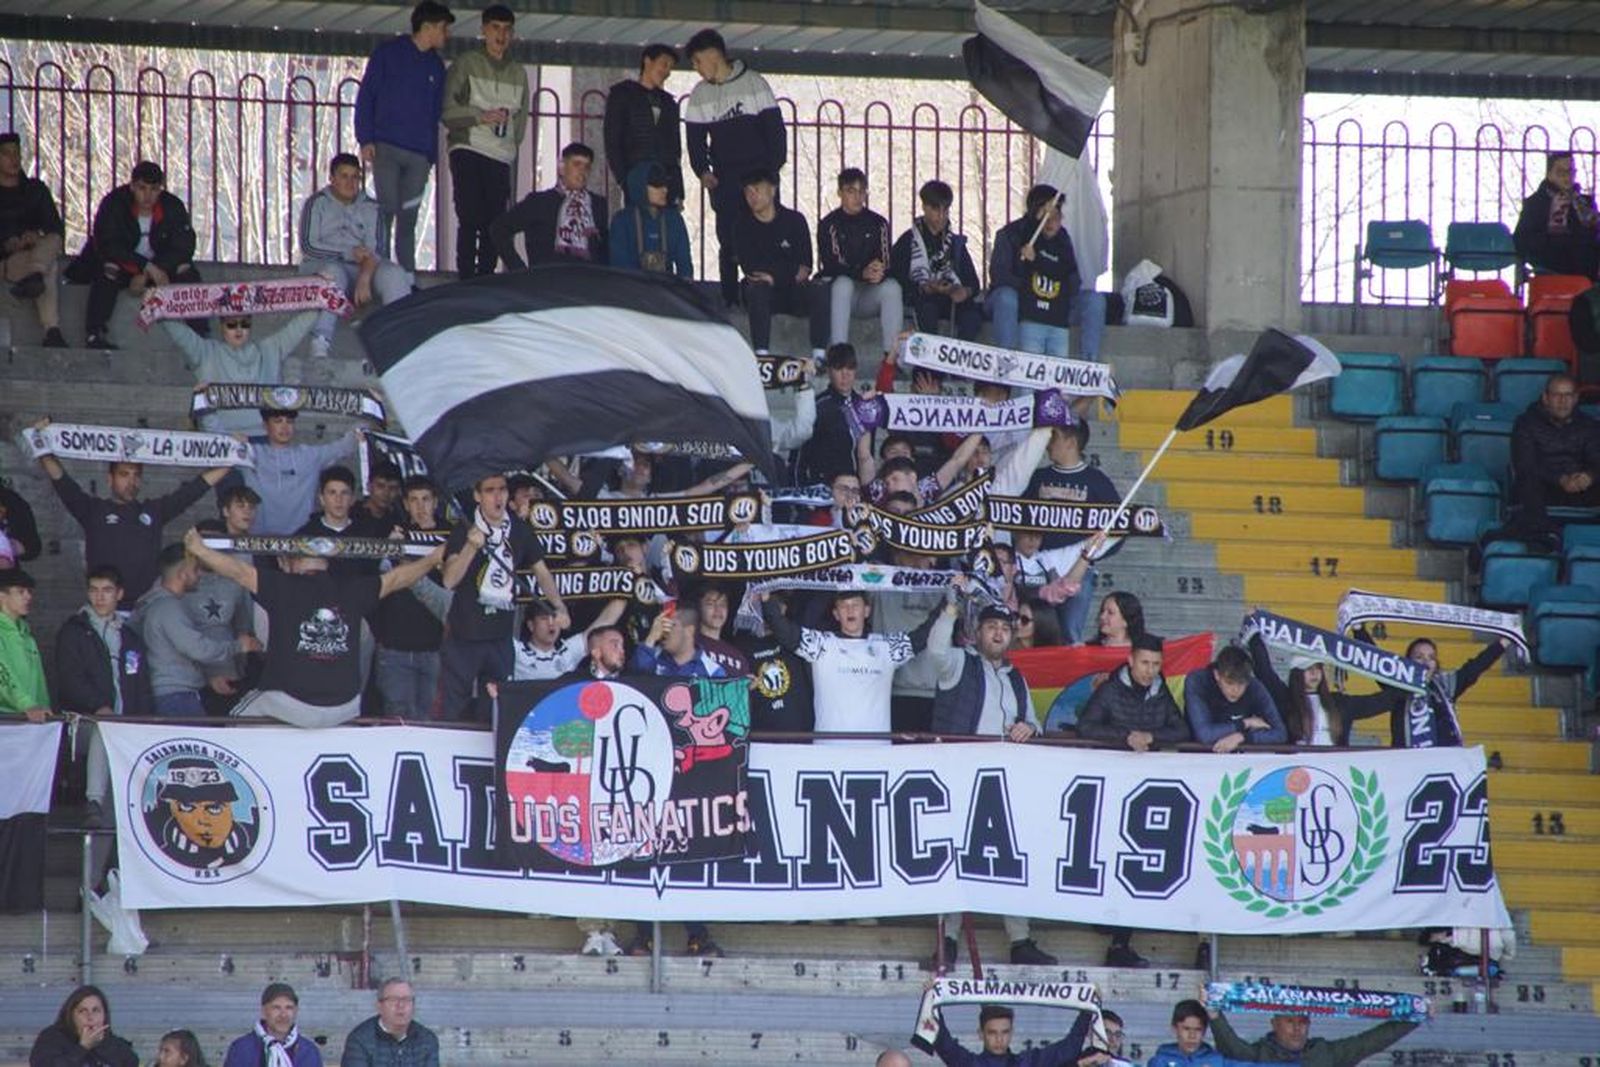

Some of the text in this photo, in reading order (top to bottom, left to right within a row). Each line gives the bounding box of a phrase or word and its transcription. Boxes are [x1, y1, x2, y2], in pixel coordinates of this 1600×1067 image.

[937, 344, 1102, 388] SOMOS LA UNIÓN
[60, 431, 231, 458] SOMOS LA UNIÓN
[1205, 429, 1234, 449] 19
[562, 502, 724, 529] UDS YOUNG BOYS
[988, 502, 1131, 529] UDS YOUNG BOYS
[898, 522, 958, 550] YOUNG
[703, 535, 850, 572] UDS YOUNG BOYS
[1308, 557, 1339, 577] 17
[526, 571, 634, 596] YNG BOYS
[1259, 616, 1328, 654] HALA
[1336, 641, 1415, 684] UNIÓN
[213, 750, 241, 769] 1923
[170, 771, 221, 783] 19 23
[509, 791, 753, 844] UDS FANATICS
[1055, 775, 1200, 900] 19
[1392, 772, 1496, 894] 23
[949, 980, 1072, 999] SALMANTINO
[1155, 971, 1182, 990] 17
